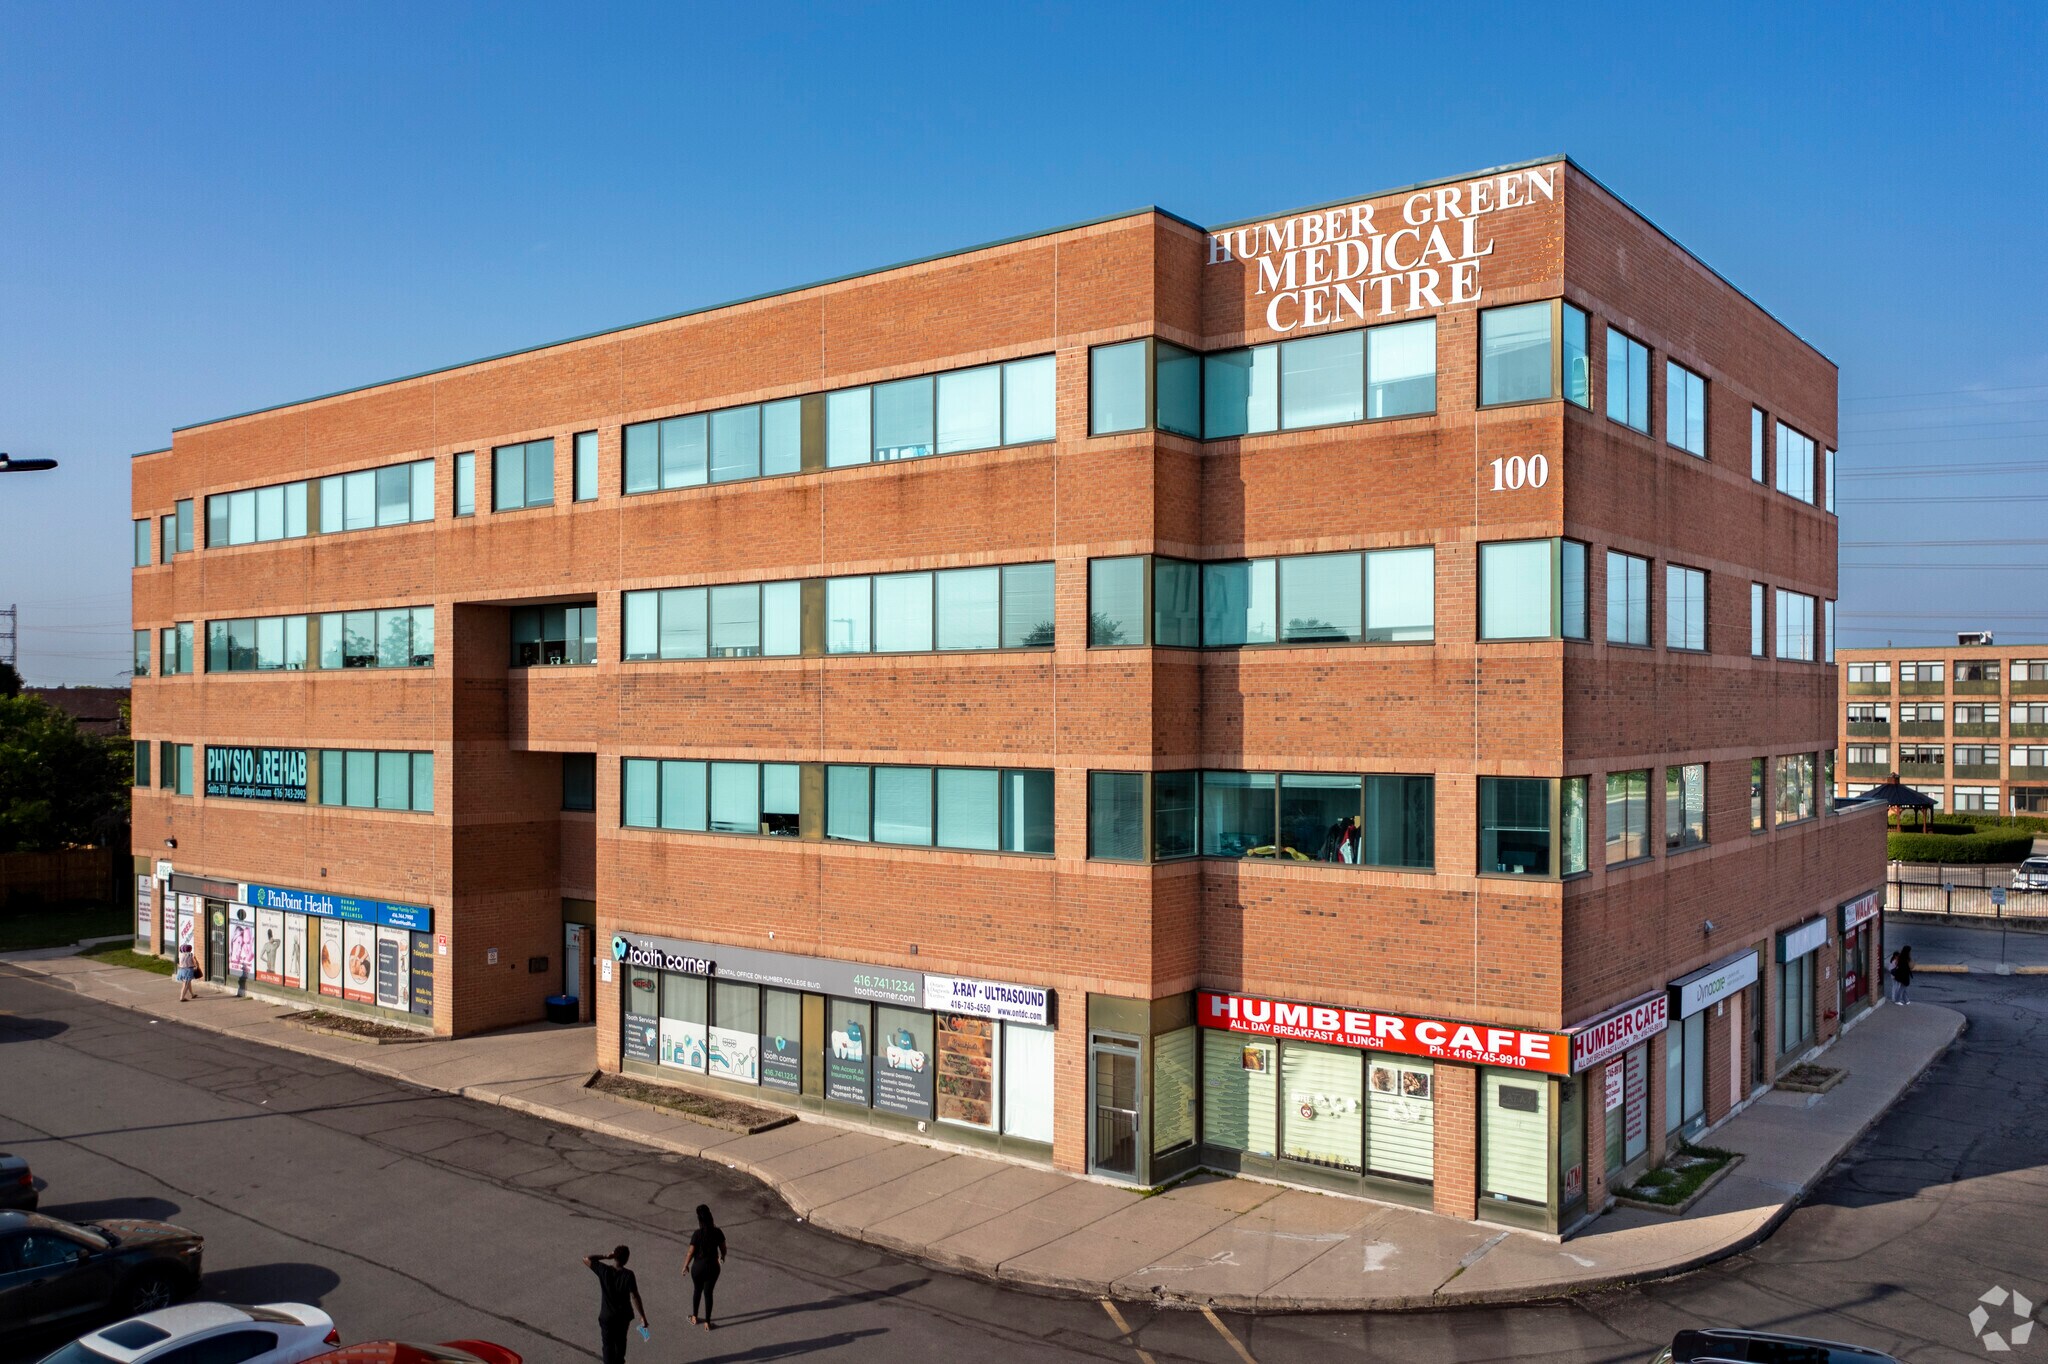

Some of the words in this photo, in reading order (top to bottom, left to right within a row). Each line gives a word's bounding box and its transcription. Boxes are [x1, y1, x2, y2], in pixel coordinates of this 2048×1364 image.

[1206, 203, 1378, 265] HUMBER
[1402, 167, 1558, 227] GREEN
[1254, 215, 1495, 295] MEDICAL
[1266, 260, 1483, 332] CENTRE
[1490, 454, 1549, 491] 100
[208, 748, 254, 783] PHYSIO
[256, 763, 262, 784] &
[263, 750, 307, 785] REHAB
[268, 889, 302, 910] PinPoint
[304, 894, 334, 914] Health
[1855, 894, 1878, 921] WALK-IN
[640, 940, 654, 948] THE
[630, 946, 662, 967] tooth
[666, 955, 710, 974] corner
[718, 968, 736, 977] DENTAL
[736, 970, 753, 979] OFFICE
[762, 974, 783, 984] HUMBER
[784, 976, 806, 987] COLLEGE
[807, 981, 821, 989] BLVD.
[853, 974, 916, 993] 416.741.1234
[854, 986, 916, 1003] toothcorner.com
[952, 982, 977, 998] X-RAY
[985, 986, 1044, 1006] ULTRASOUND
[951, 1000, 991, 1013] 416-745-4550
[639, 1016, 657, 1024] Services
[1211, 996, 1406, 1040] HUMBER
[1415, 1022, 1550, 1059] CAFE
[1574, 1013, 1633, 1060] HUMBER
[1635, 998, 1665, 1031] CAFE
[1230, 1019, 1249, 1030] ALL
[1251, 1022, 1271, 1032] DAY
[1273, 1024, 1334, 1041] BREAKFAST
[1336, 1033, 1344, 1042] &
[1347, 1034, 1384, 1048] LUNCH
[764, 1052, 778, 1061] tooth
[779, 1055, 797, 1064] corner
[1429, 1045, 1444, 1056] Ph
[1453, 1048, 1526, 1066] 416-745-9910
[1594, 1048, 1612, 1061] BREAKFAST
[841, 1065, 856, 1074] Accept
[764, 1076, 797, 1087] toothcorner.com
[833, 1083, 863, 1094] Interest-Free
[831, 1090, 851, 1098] Payment
[852, 1093, 865, 1101] Plans
[1566, 1166, 1581, 1189] ATM
